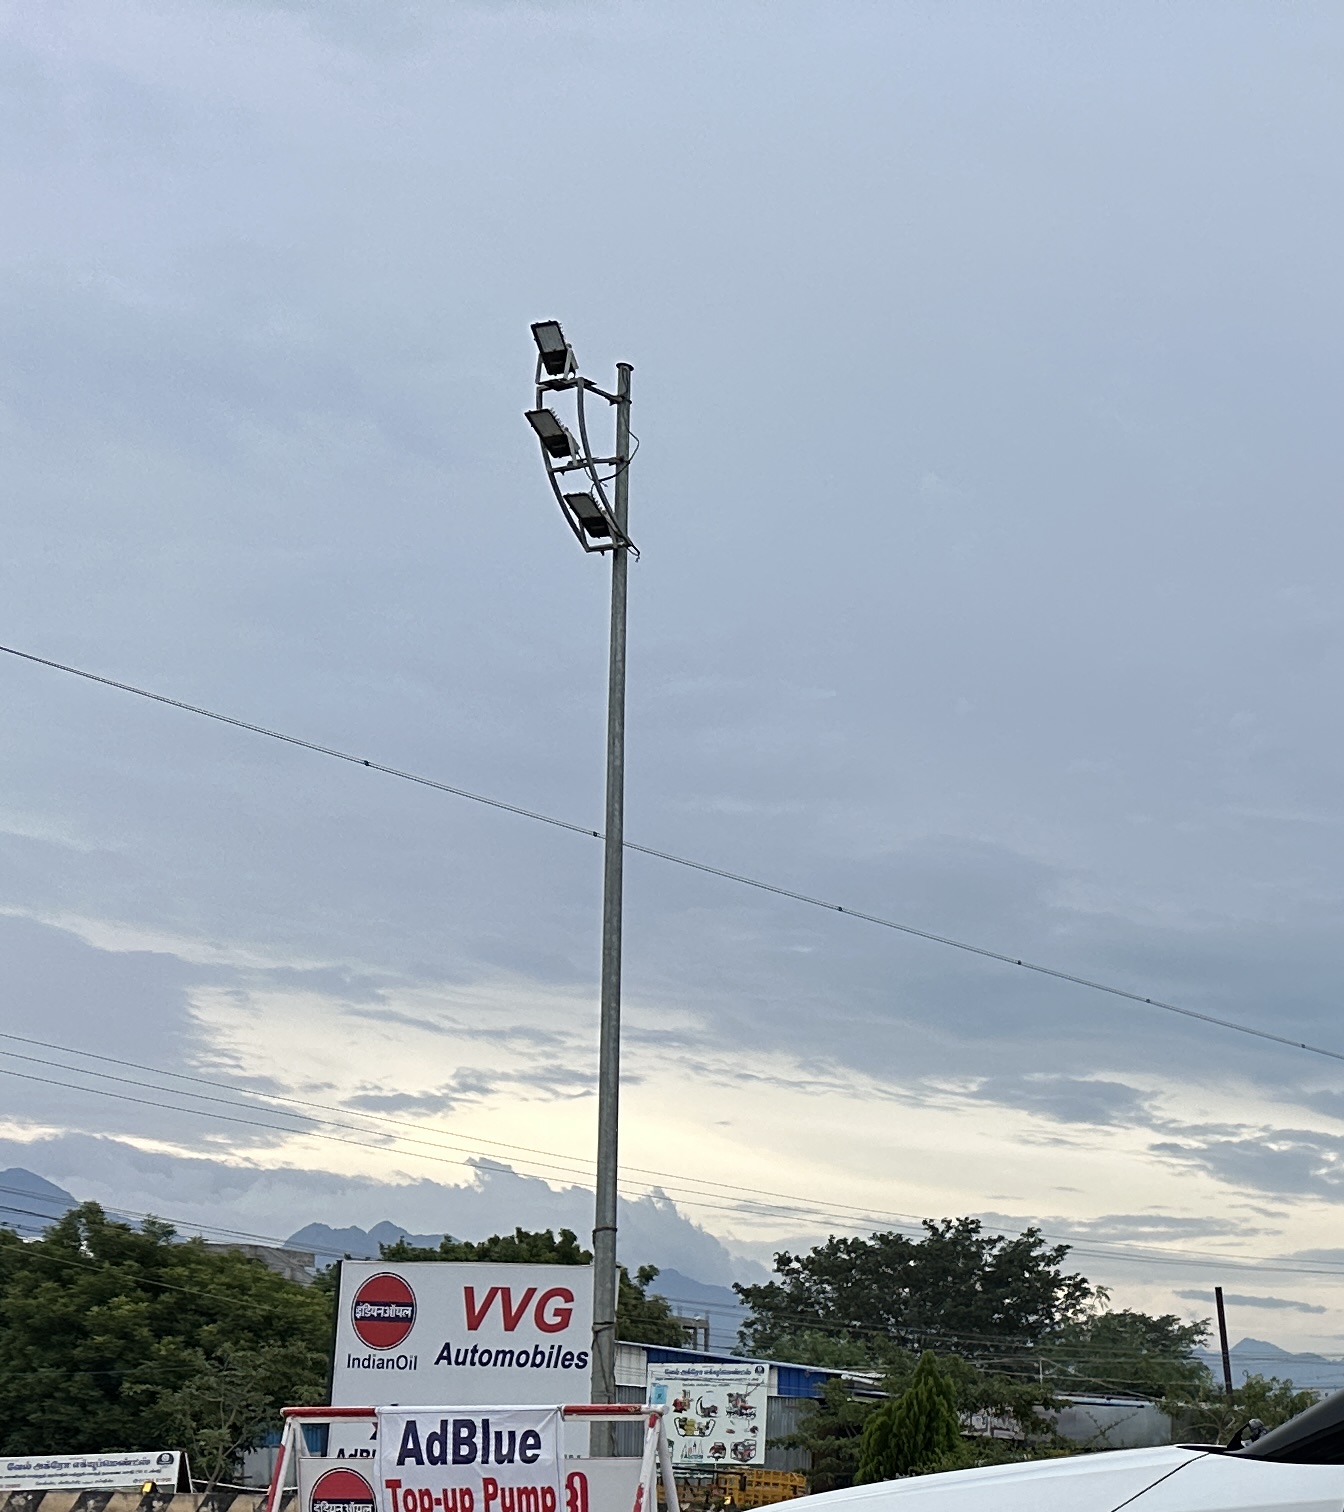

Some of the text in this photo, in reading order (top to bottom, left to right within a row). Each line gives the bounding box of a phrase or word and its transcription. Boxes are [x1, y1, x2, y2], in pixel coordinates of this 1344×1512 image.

[463, 1286, 575, 1333] VVG
[346, 1353, 417, 1371] IndianOil
[434, 1342, 589, 1369] Automobiles
[396, 1418, 542, 1466] AdBlue
